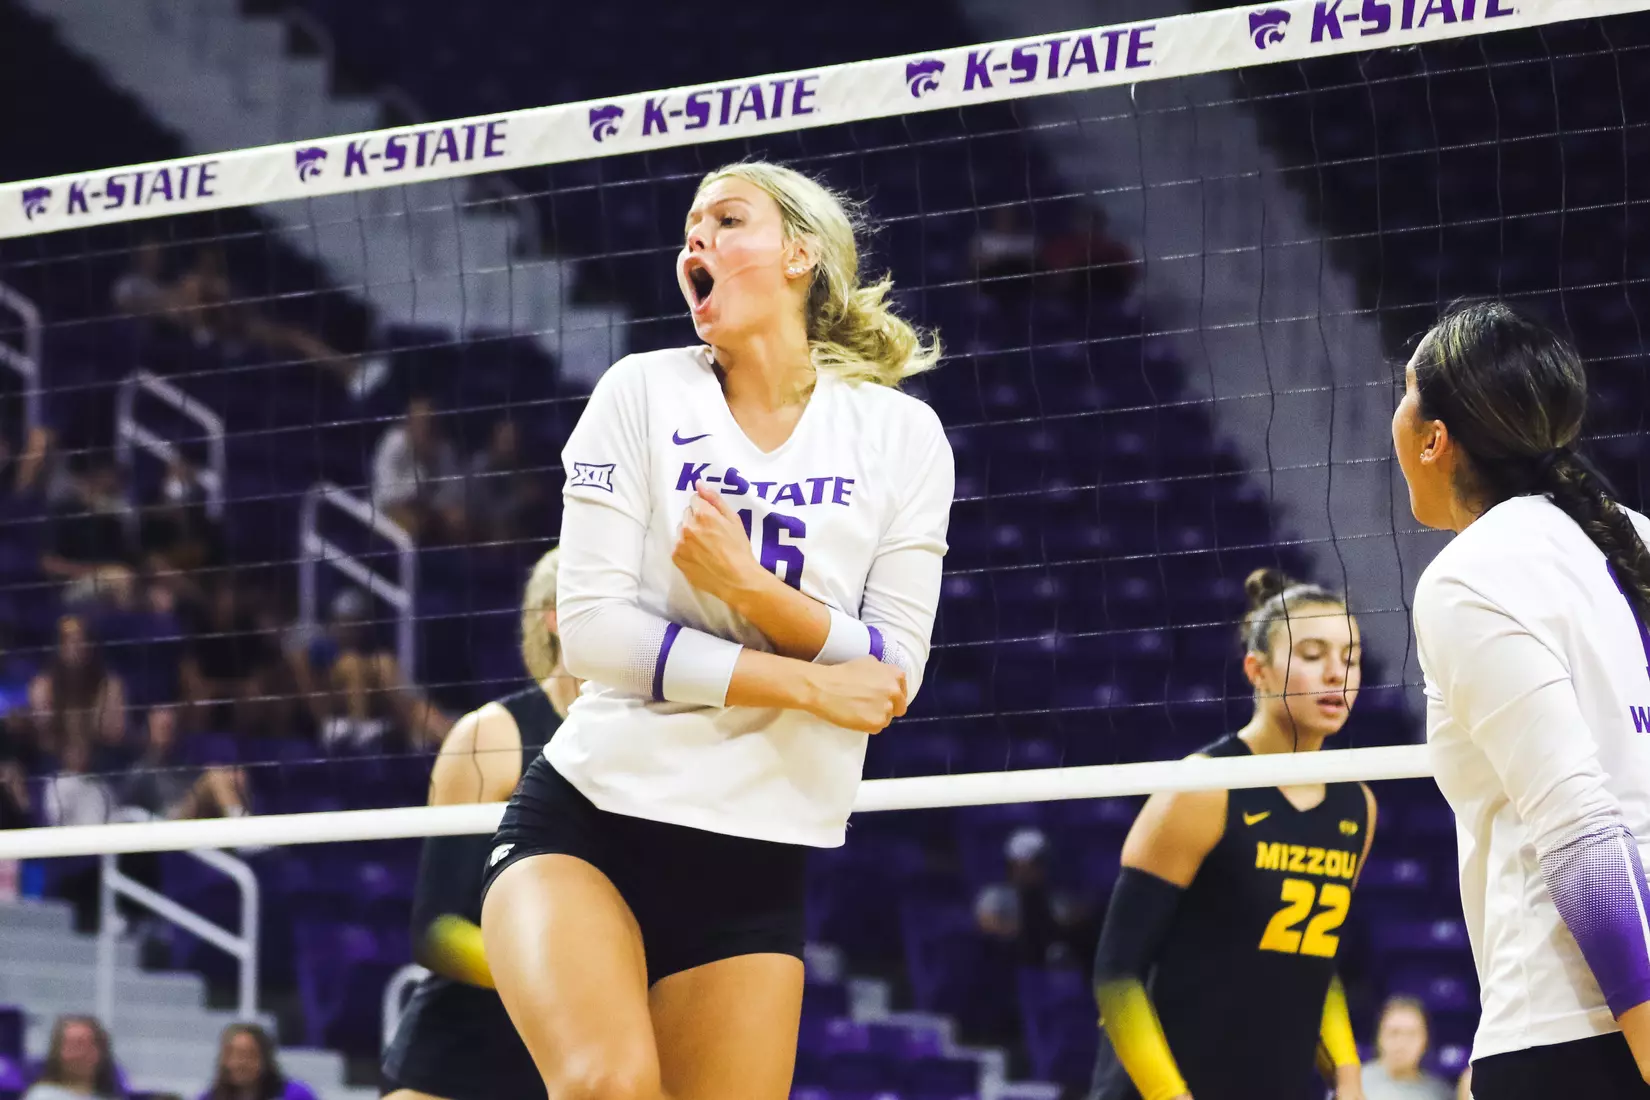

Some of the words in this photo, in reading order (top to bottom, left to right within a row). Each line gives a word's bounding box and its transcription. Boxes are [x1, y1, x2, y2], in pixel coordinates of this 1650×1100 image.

[963, 25, 1156, 91] K-STATE
[642, 75, 819, 137] K-STATE
[344, 119, 508, 178] K-STATE
[67, 160, 219, 215] K-STATE
[675, 462, 855, 507] K-STATE
[1255, 841, 1357, 879] MIZZOU
[1258, 878, 1351, 958] 22
